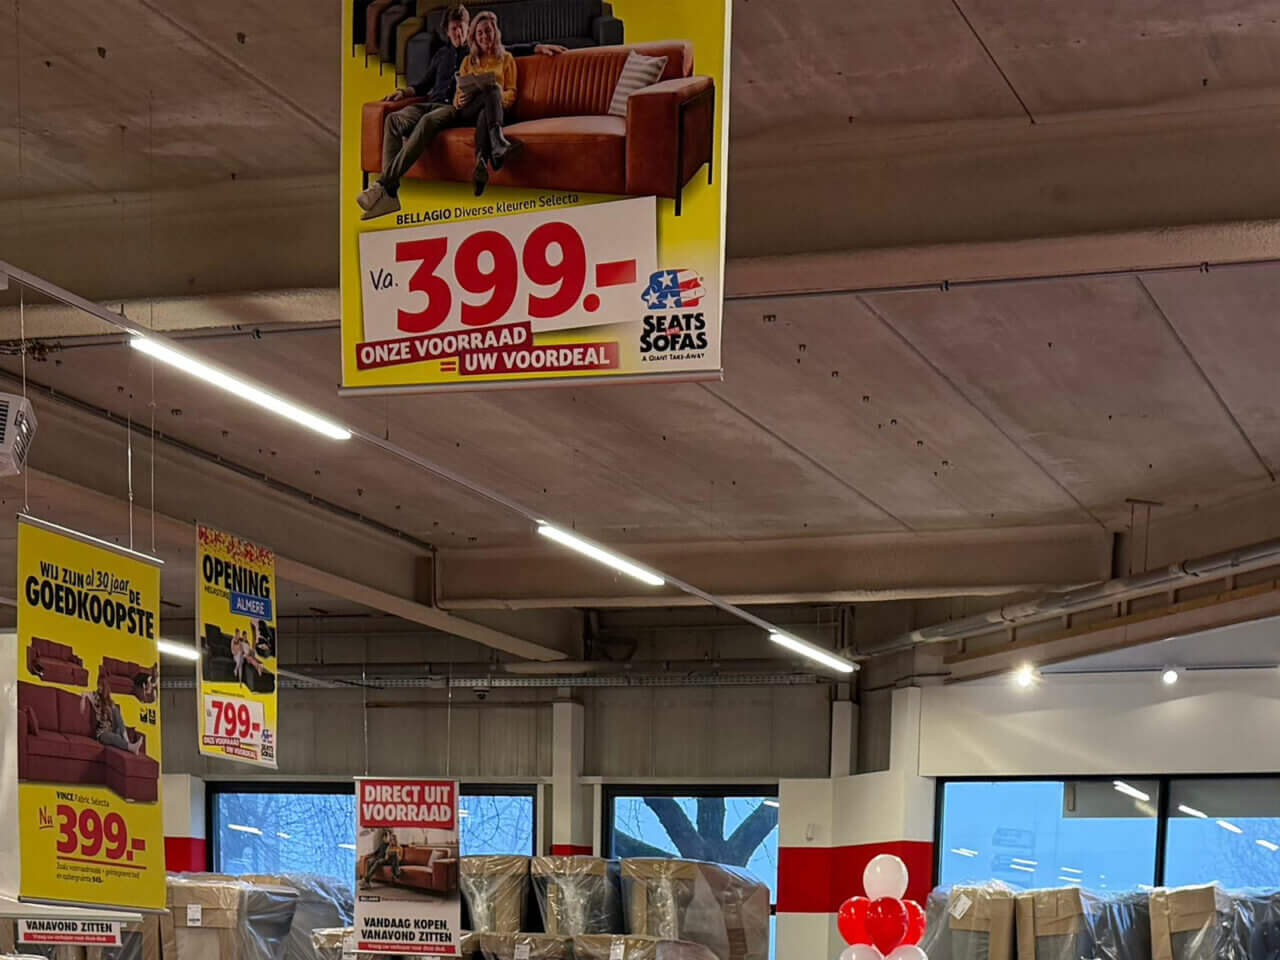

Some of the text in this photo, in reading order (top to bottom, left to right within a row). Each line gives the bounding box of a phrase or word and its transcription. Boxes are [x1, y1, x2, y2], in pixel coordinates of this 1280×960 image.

[396, 192, 580, 225] BELLAGIO Diverse kleuren Selecta
[643, 312, 706, 333] SEATS
[361, 326, 527, 365] ONZE VOORRAAD
[640, 332, 708, 353] SOFAS
[465, 352, 498, 372] UW
[502, 346, 610, 370] VOORDEAL
[40, 561, 129, 595] WIJ ZIJN al 30 jaar
[203, 554, 270, 599] OPENING
[25, 575, 154, 640] GOEDKOOPSTE
[129, 589, 141, 606] DE
[236, 597, 265, 615] ALMERE
[364, 785, 450, 804] DIRECT UIT
[362, 804, 452, 822] VOORRAAD
[25, 920, 112, 933] VANAVOND ZITTEN
[363, 917, 450, 932] VANDAAG KOPEN,
[361, 929, 452, 943] VANAVOND ZITTEN
